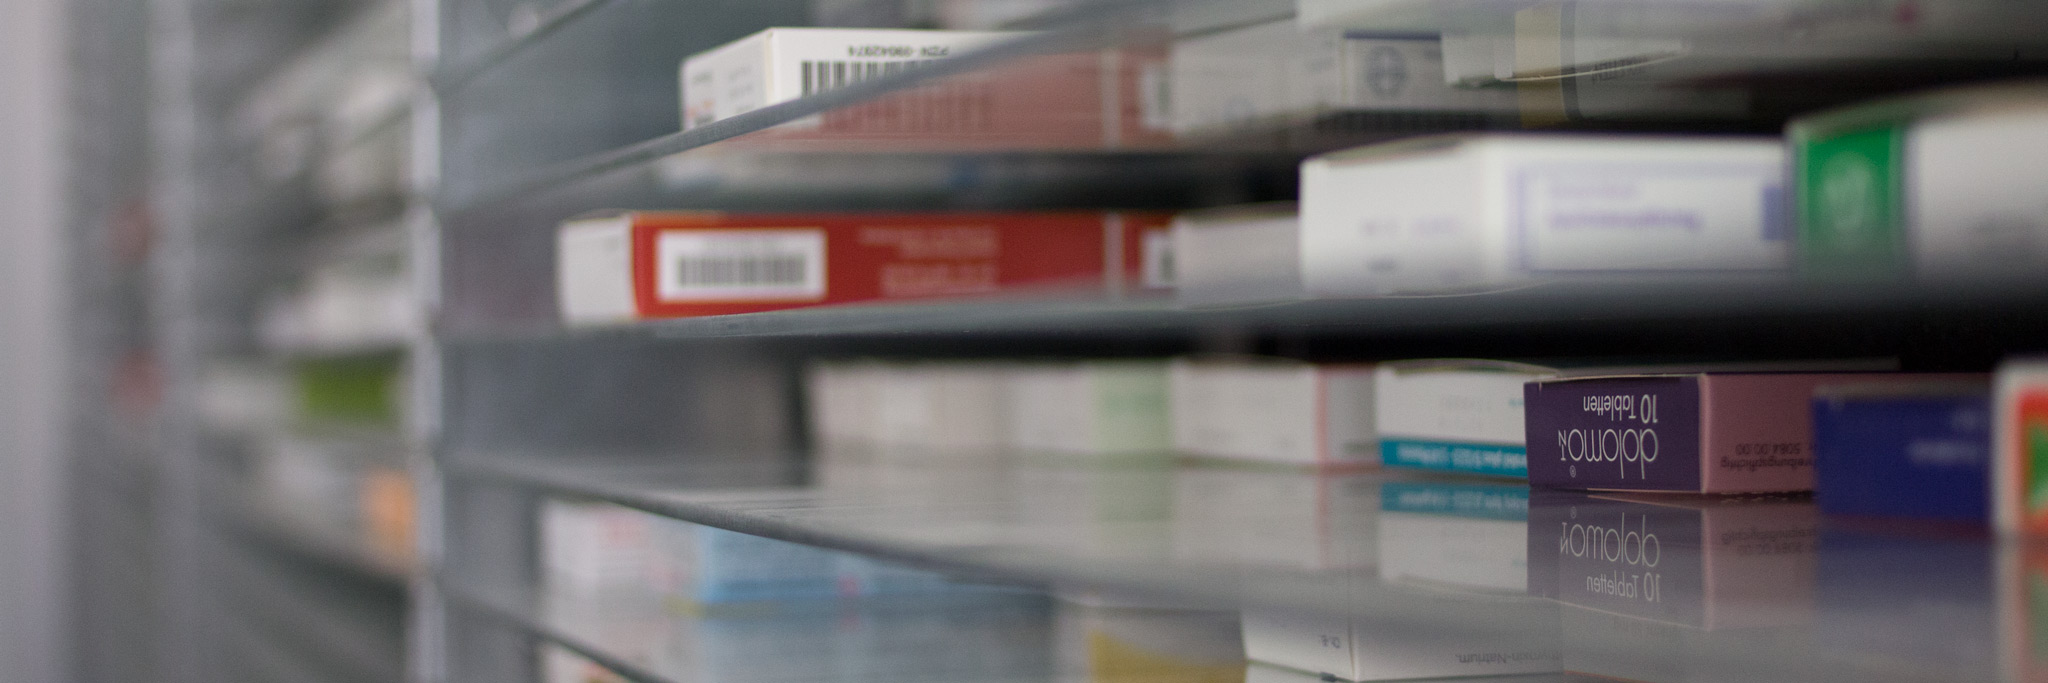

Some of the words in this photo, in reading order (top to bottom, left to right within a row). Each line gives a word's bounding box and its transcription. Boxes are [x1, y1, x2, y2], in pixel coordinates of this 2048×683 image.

[1583, 394, 1636, 420] Tabletten
[1641, 394, 1658, 423] 10
[1567, 428, 1658, 480] dolomo
